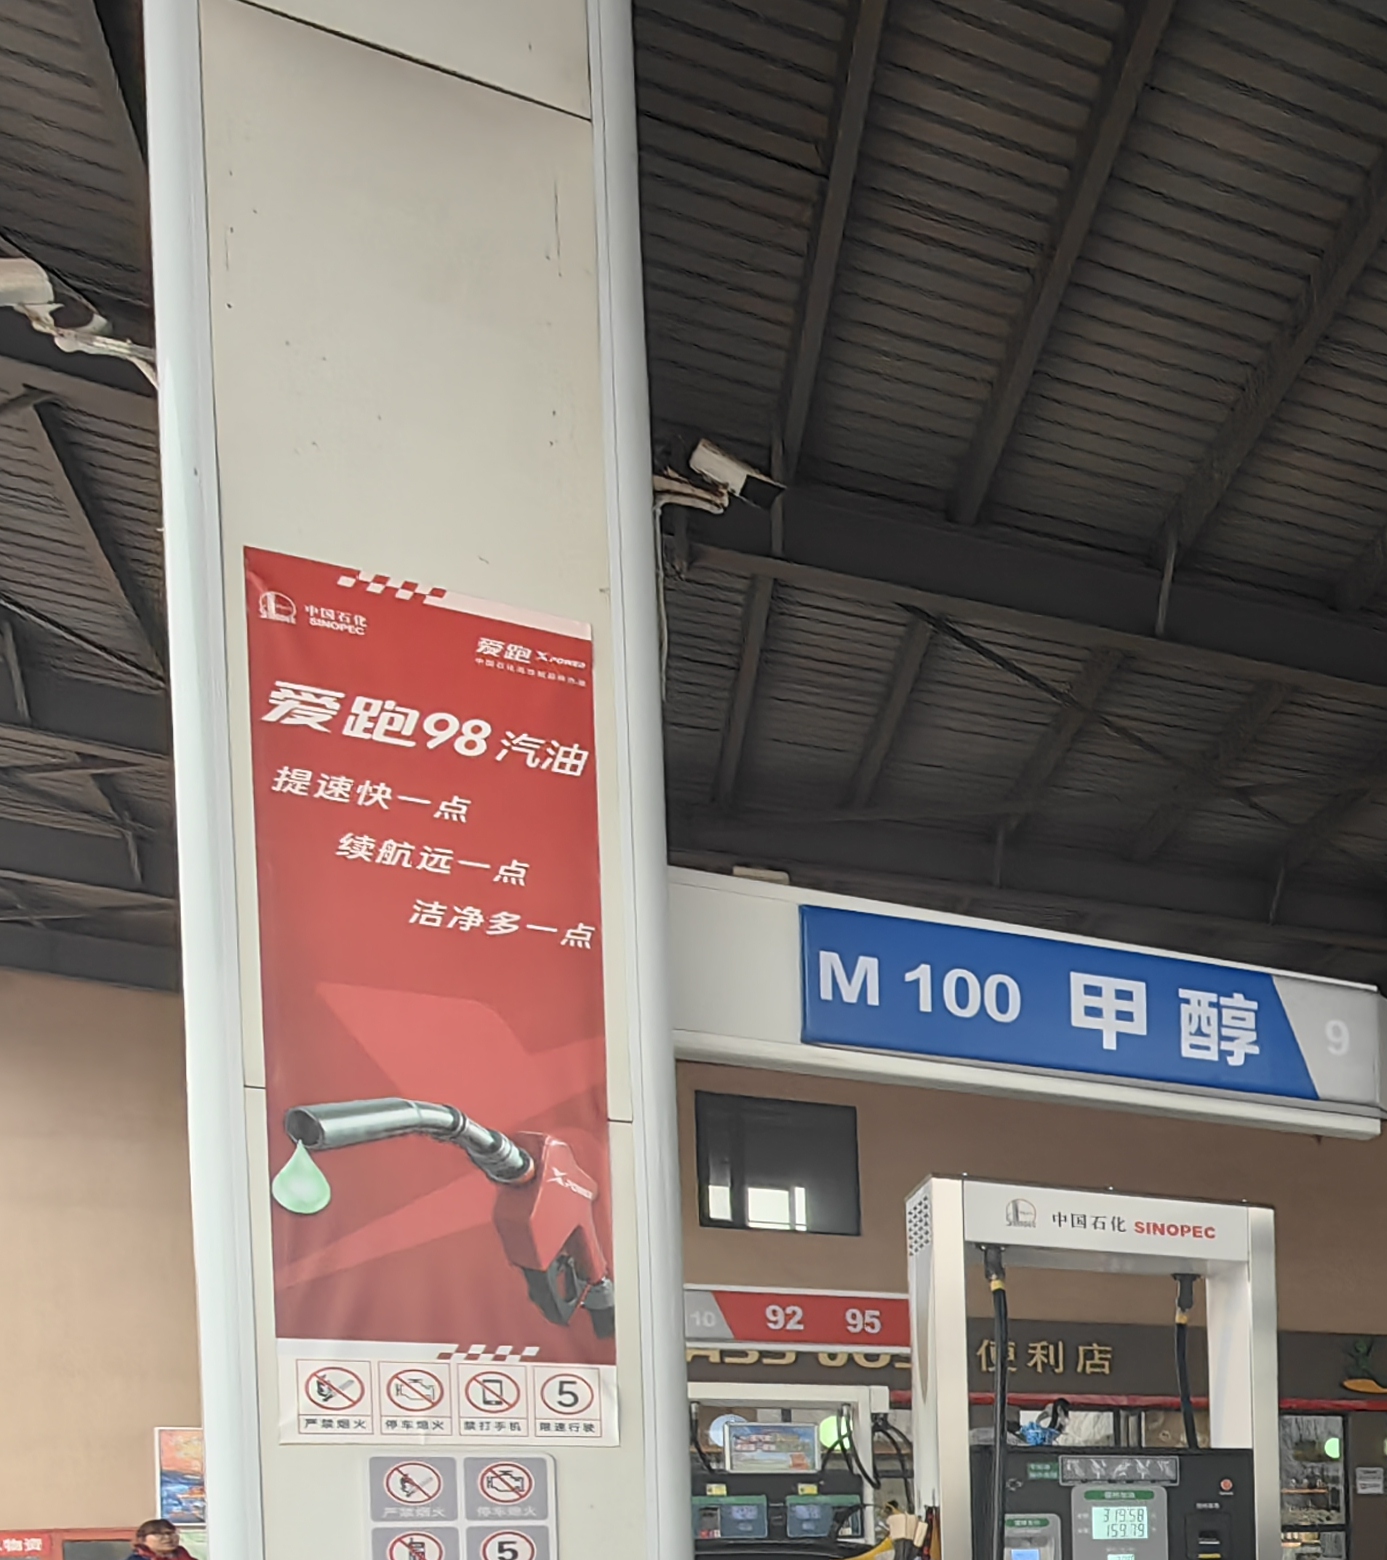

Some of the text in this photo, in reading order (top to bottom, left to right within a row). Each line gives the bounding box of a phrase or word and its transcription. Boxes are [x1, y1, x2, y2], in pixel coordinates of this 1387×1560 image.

[271, 766, 472, 822] 提速快一点
[335, 832, 530, 886] 续航远一点
[409, 899, 596, 949] 洁净多一点
[818, 950, 880, 1008] M
[904, 963, 1021, 1024] 100
[1325, 1019, 1350, 1056] 9
[1052, 1211, 1127, 1233] 中国石化
[1133, 1221, 1217, 1239] SINOPEC
[690, 1304, 883, 1334] 10 92 95
[555, 1380, 580, 1408] 5
[304, 1418, 367, 1430] 严禁烟火
